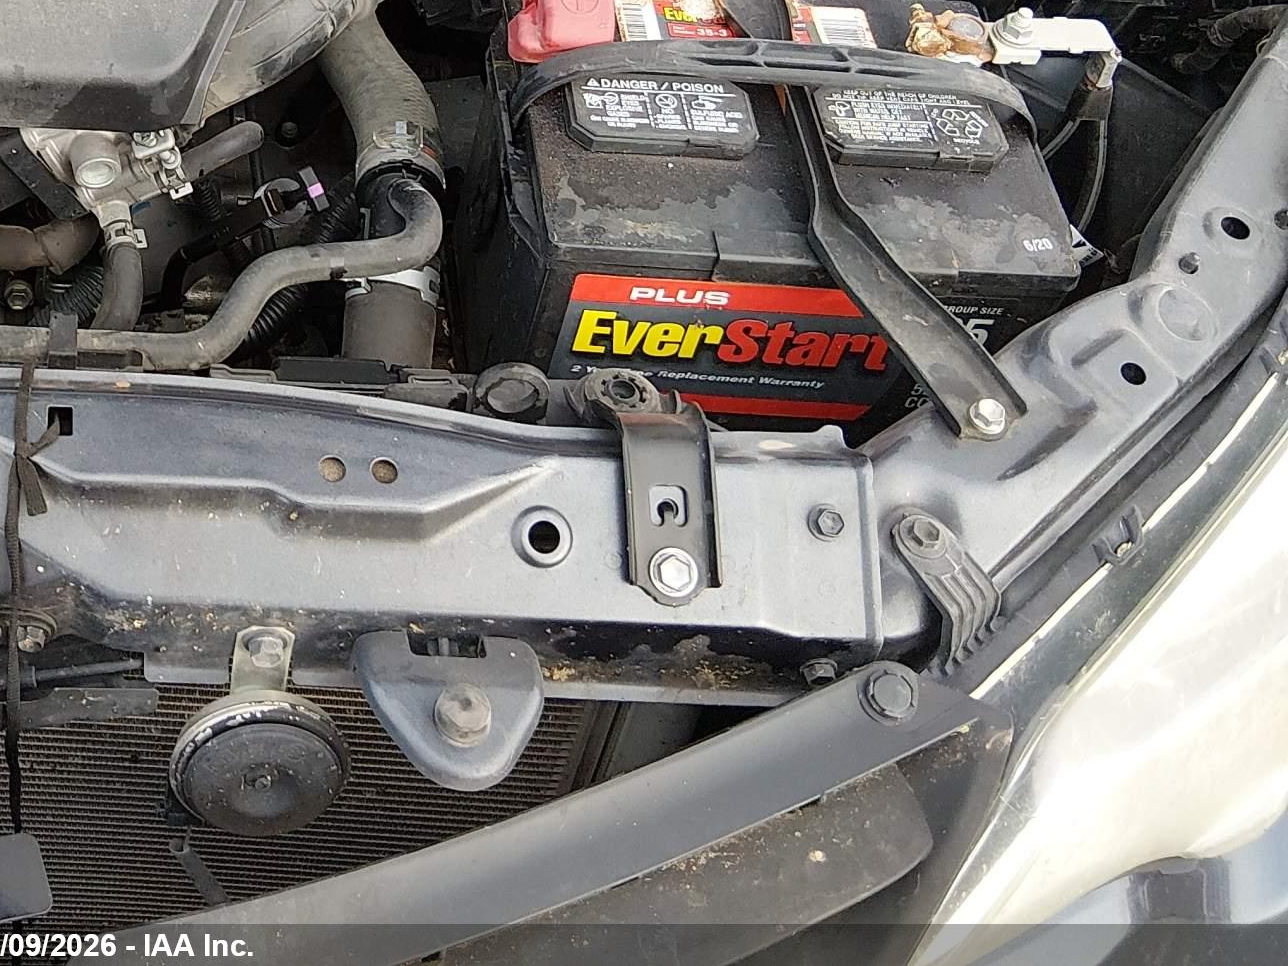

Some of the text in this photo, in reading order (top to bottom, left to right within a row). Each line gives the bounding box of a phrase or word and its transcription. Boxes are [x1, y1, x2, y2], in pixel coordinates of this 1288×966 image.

[600, 78, 658, 91] DANGER
[672, 83, 724, 93] POISON
[1022, 238, 1054, 252] 6/20
[628, 286, 731, 306] PLUS
[979, 307, 1005, 315] SIZE
[571, 309, 889, 371] EverStart
[569, 364, 582, 373] 2
[657, 370, 755, 384] Replacement
[759, 376, 825, 390] Warranty
